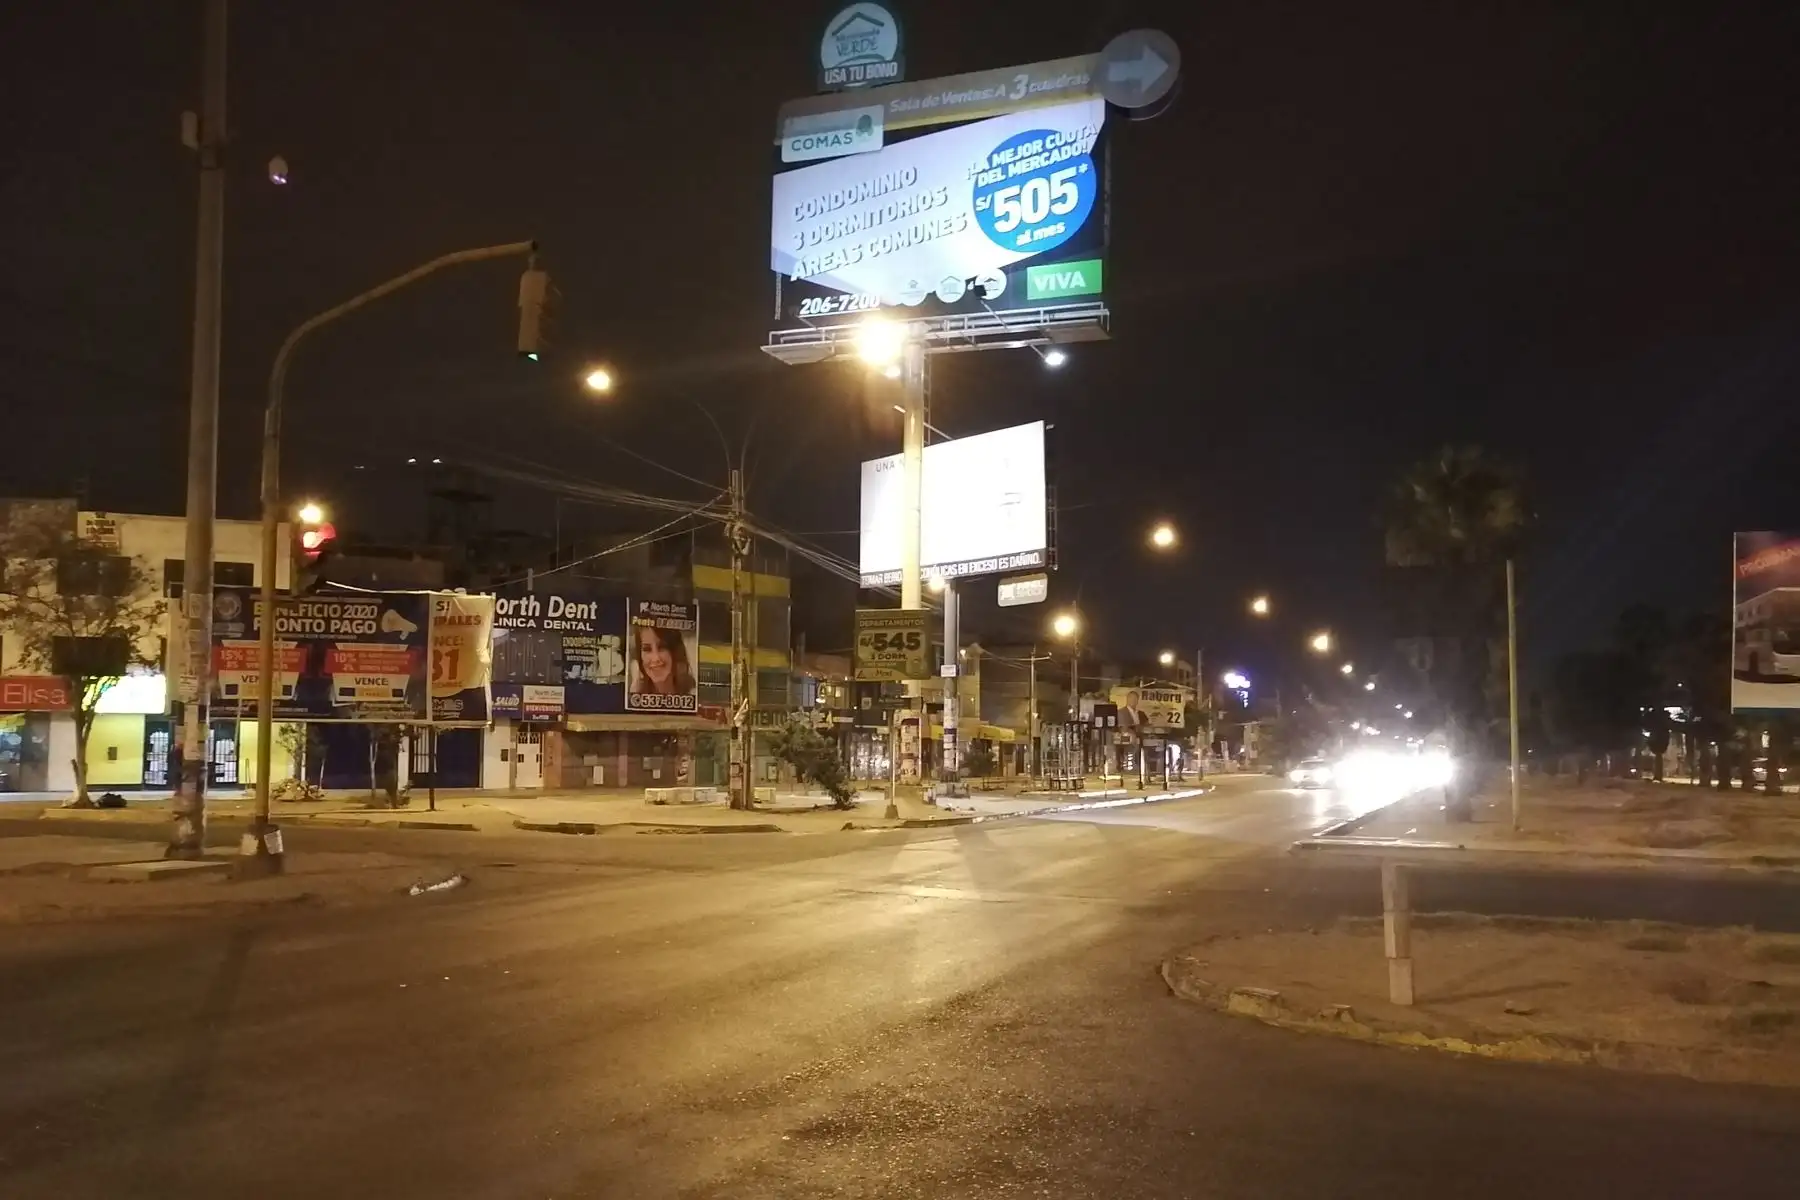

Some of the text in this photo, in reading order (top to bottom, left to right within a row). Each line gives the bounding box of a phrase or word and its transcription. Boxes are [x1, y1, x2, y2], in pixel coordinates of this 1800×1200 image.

[824, 62, 898, 84] USA TU BONO
[891, 99, 920, 112] Sala
[923, 96, 940, 108] de
[1010, 74, 1029, 100] 3
[1029, 73, 1091, 93] cuadras
[791, 132, 853, 151] COMAS
[991, 139, 1043, 166] MEJOR
[1045, 123, 1098, 149] CUOTA
[977, 168, 1006, 187] DEL
[793, 166, 918, 222] CONDOMINIO
[809, 186, 949, 247] DORMITORIOS
[869, 212, 968, 258] COMUNES
[1016, 222, 1066, 246] al mes
[1034, 270, 1086, 292] VIVA
[875, 460, 896, 473] UNA
[969, 559, 998, 573] EXCESO
[999, 558, 1009, 569] ES
[254, 602, 378, 619] BNEFICIO 2020
[548, 596, 598, 619] Dent
[650, 602, 687, 614] North Dent
[253, 619, 326, 634] PONTO
[330, 620, 377, 634] PAGO
[493, 617, 594, 631] LINICA DENTAL
[873, 631, 921, 652] 545
[354, 677, 389, 686] VENCE:
[4, 683, 67, 705] Elisa
[495, 694, 520, 706] SALUD
[642, 694, 694, 709] 537-8012
[1167, 711, 1181, 723] 22
